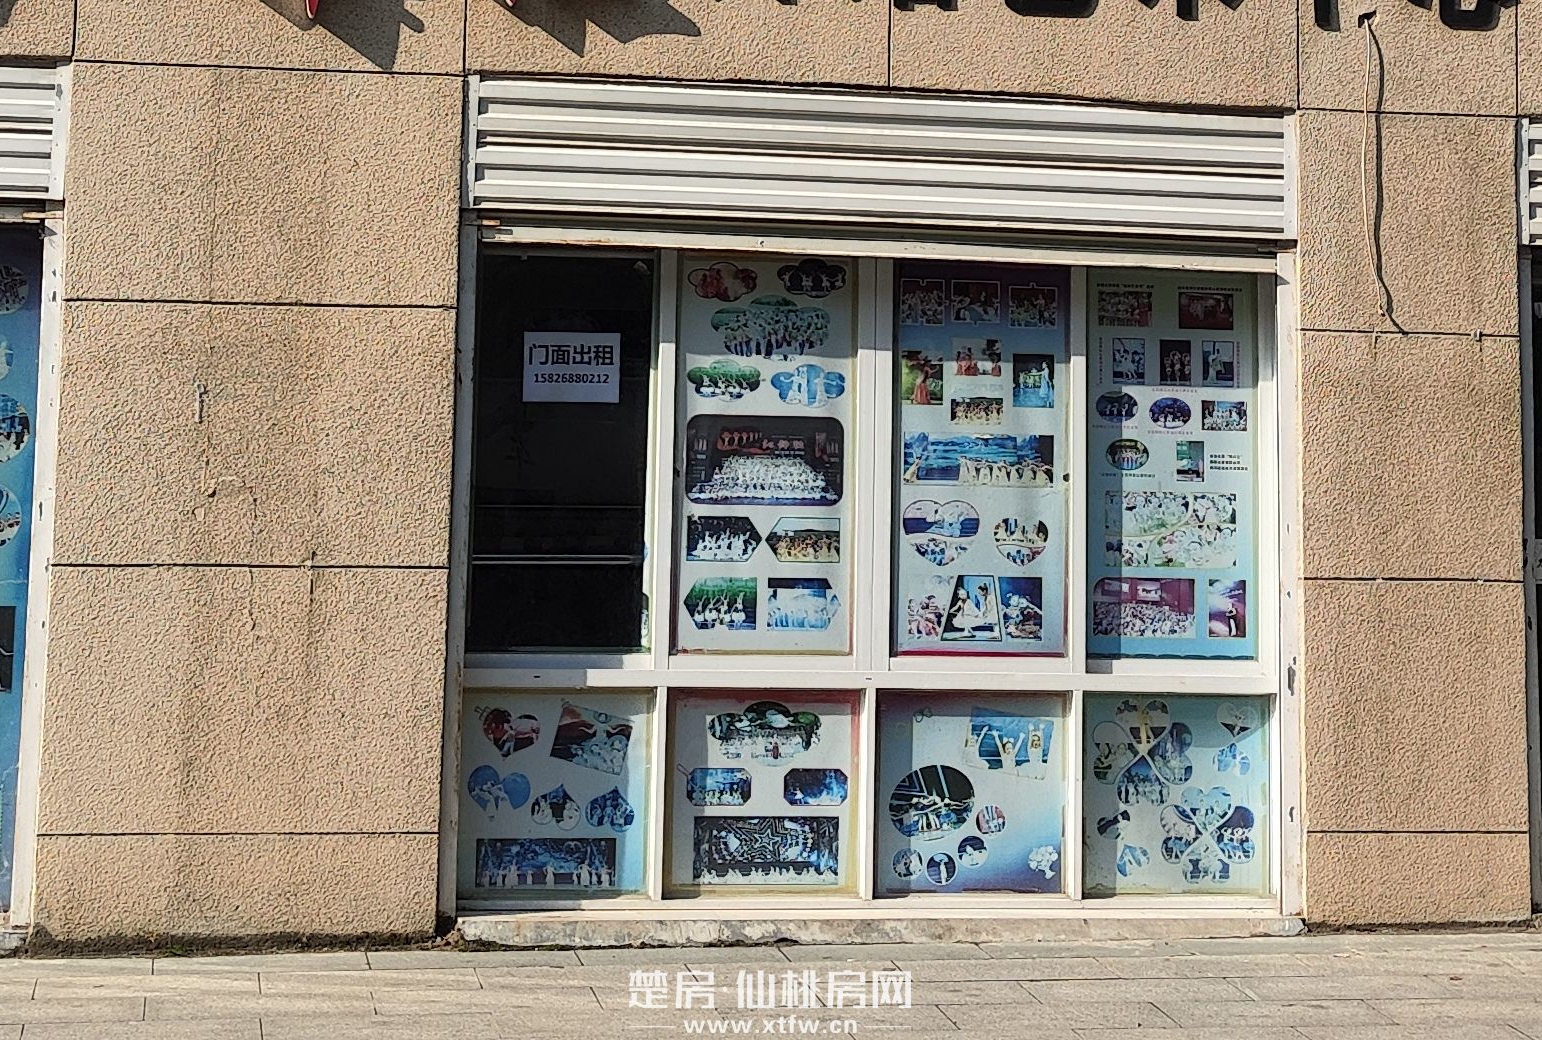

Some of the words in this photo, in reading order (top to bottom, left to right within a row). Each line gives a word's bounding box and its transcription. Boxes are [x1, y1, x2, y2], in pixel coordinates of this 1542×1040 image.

[528, 343, 615, 366] 门面出租
[533, 372, 610, 384] 15826880212
